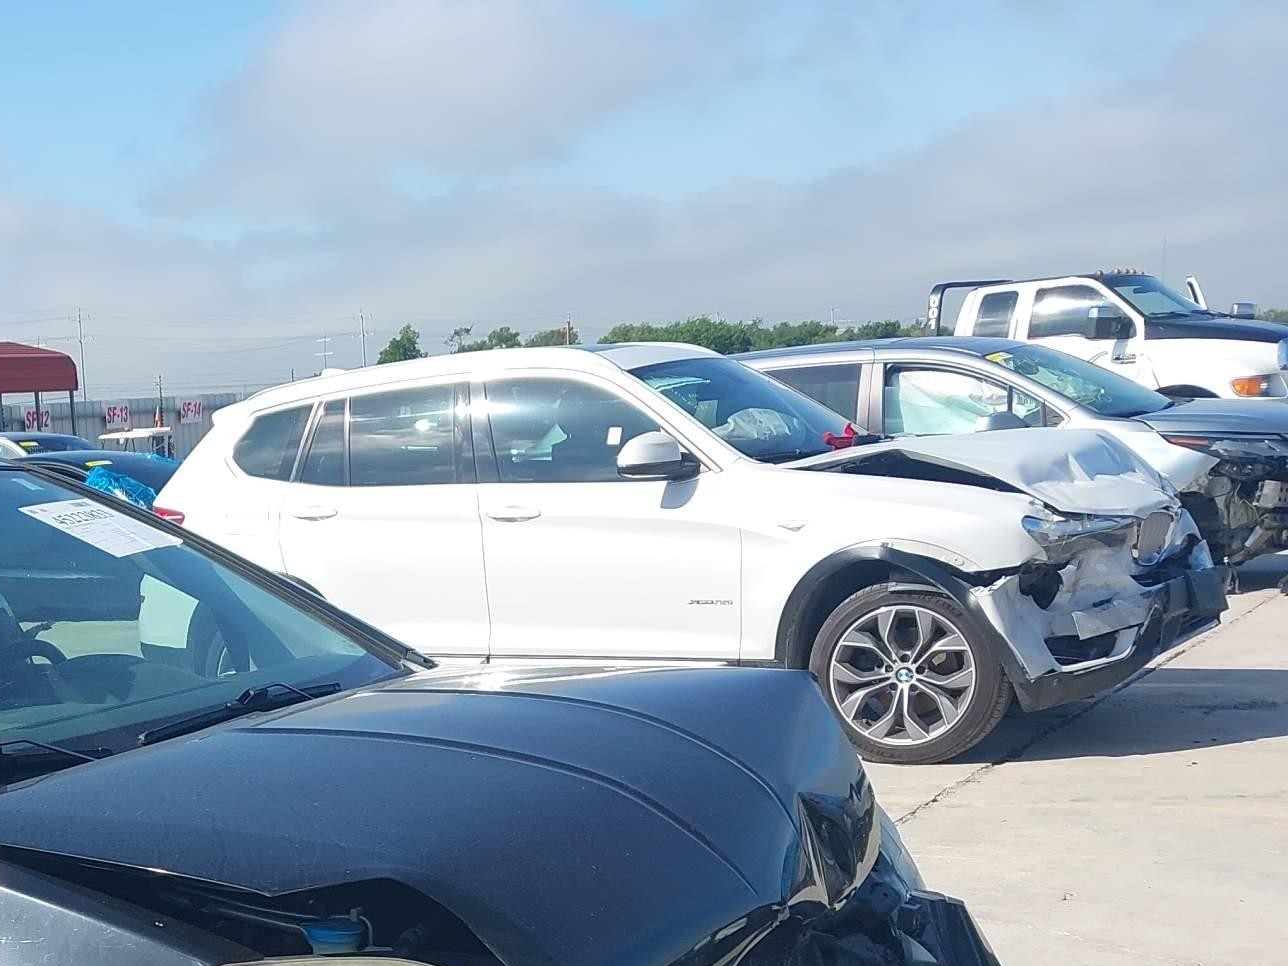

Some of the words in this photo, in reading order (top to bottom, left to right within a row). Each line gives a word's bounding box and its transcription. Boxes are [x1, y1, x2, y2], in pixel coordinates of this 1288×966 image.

[929, 294, 940, 330] 001
[107, 406, 128, 424] SF-13
[182, 402, 201, 419] SF-14
